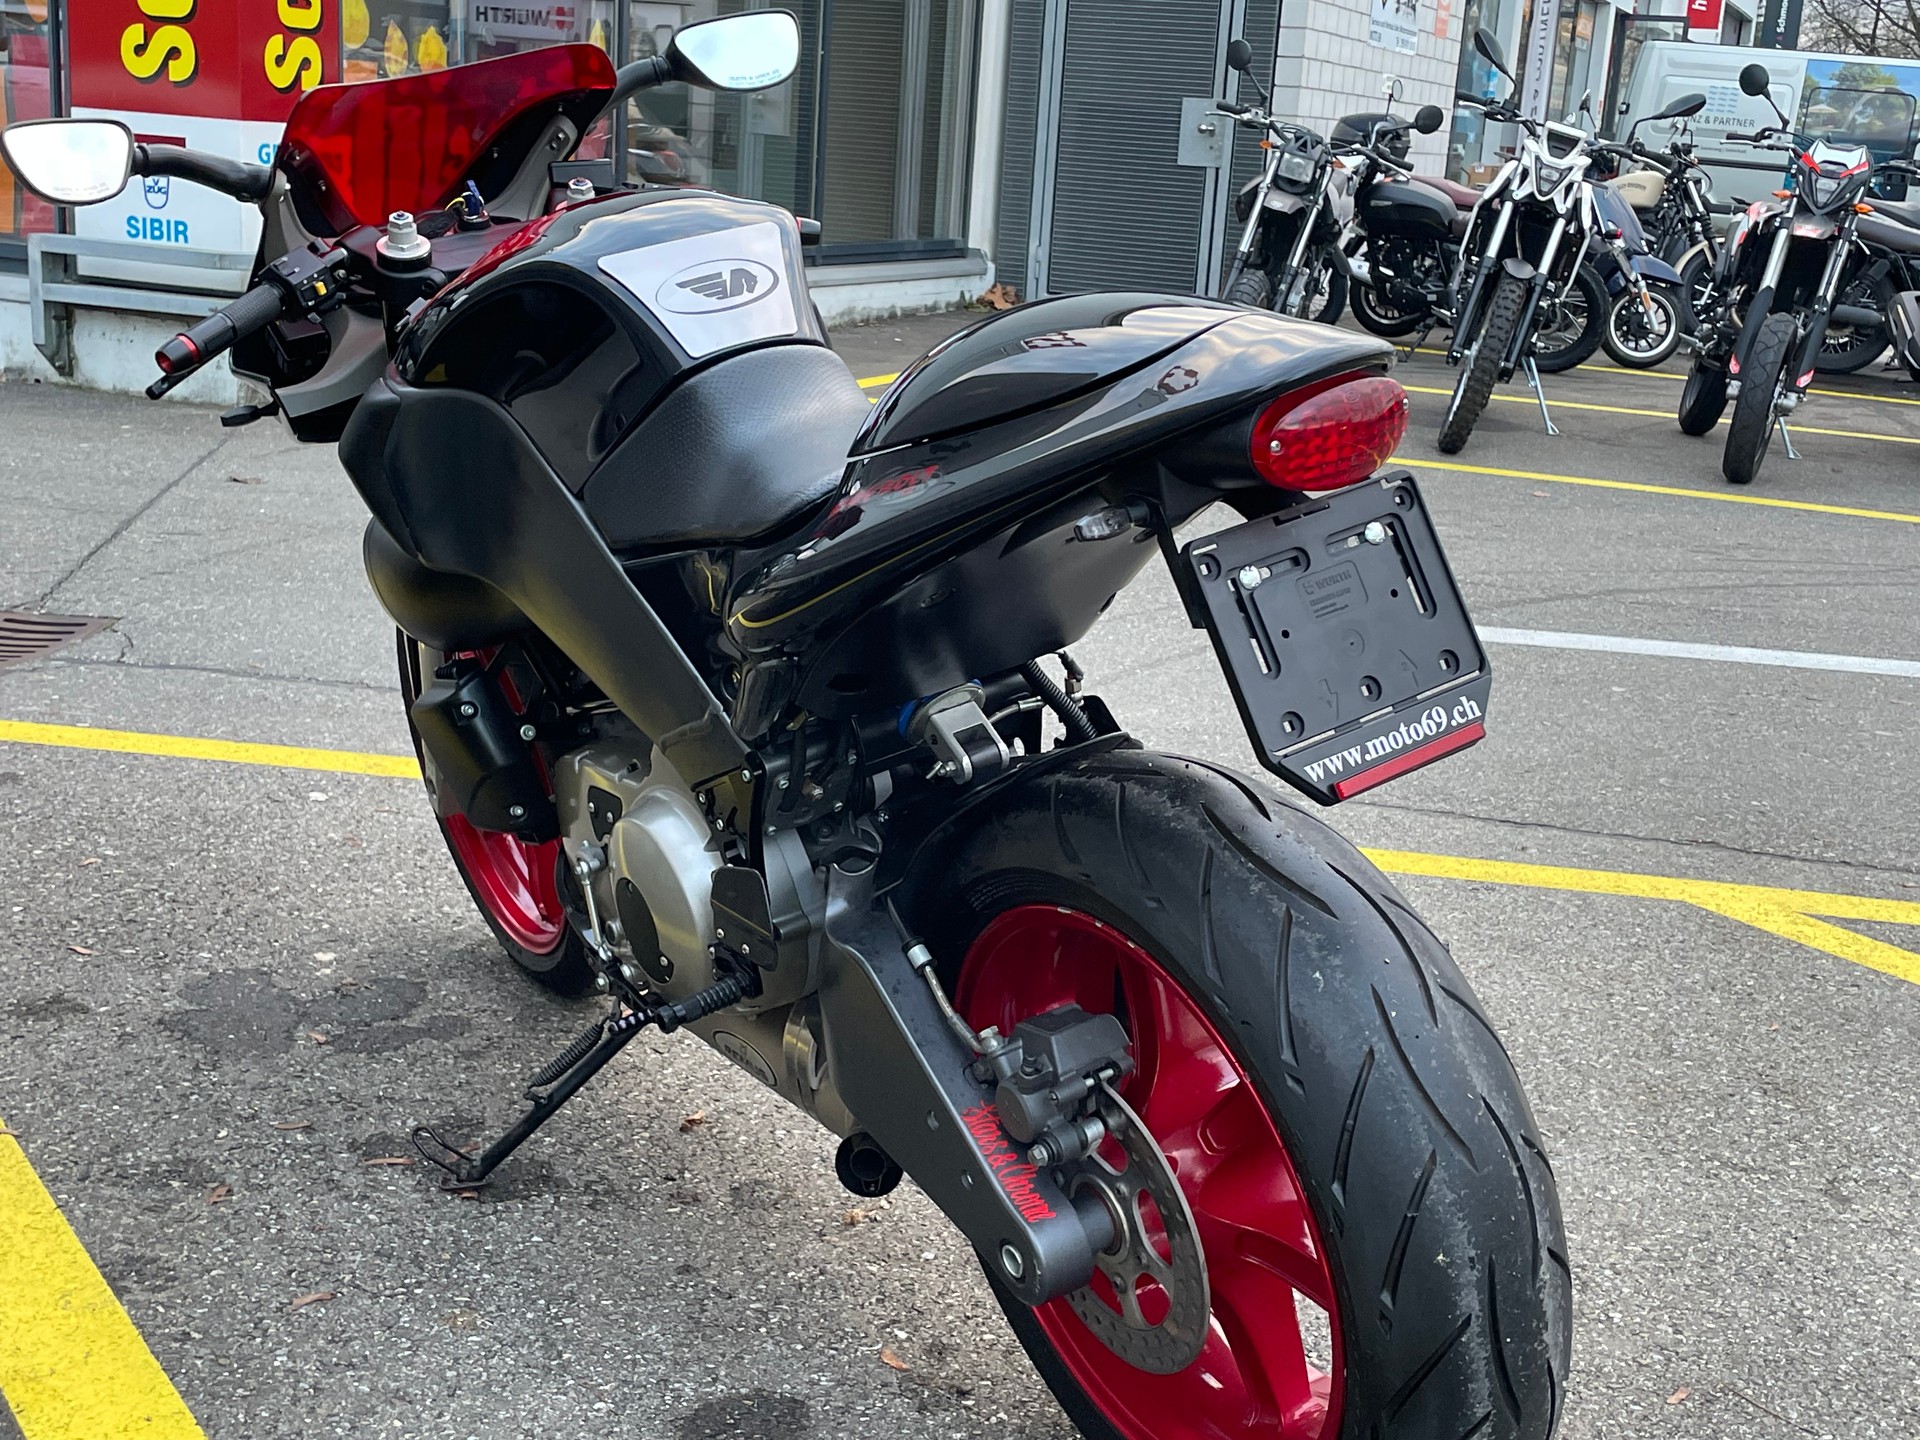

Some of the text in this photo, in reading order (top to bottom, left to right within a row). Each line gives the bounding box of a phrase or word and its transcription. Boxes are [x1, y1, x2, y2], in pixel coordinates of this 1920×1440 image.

[1775, 0, 1789, 33] Schmo
[1704, 115, 1711, 125] &
[1713, 116, 1755, 128] PARTNER
[126, 215, 189, 244] SIBIR
[1303, 695, 1482, 783] www.moto69.ch
